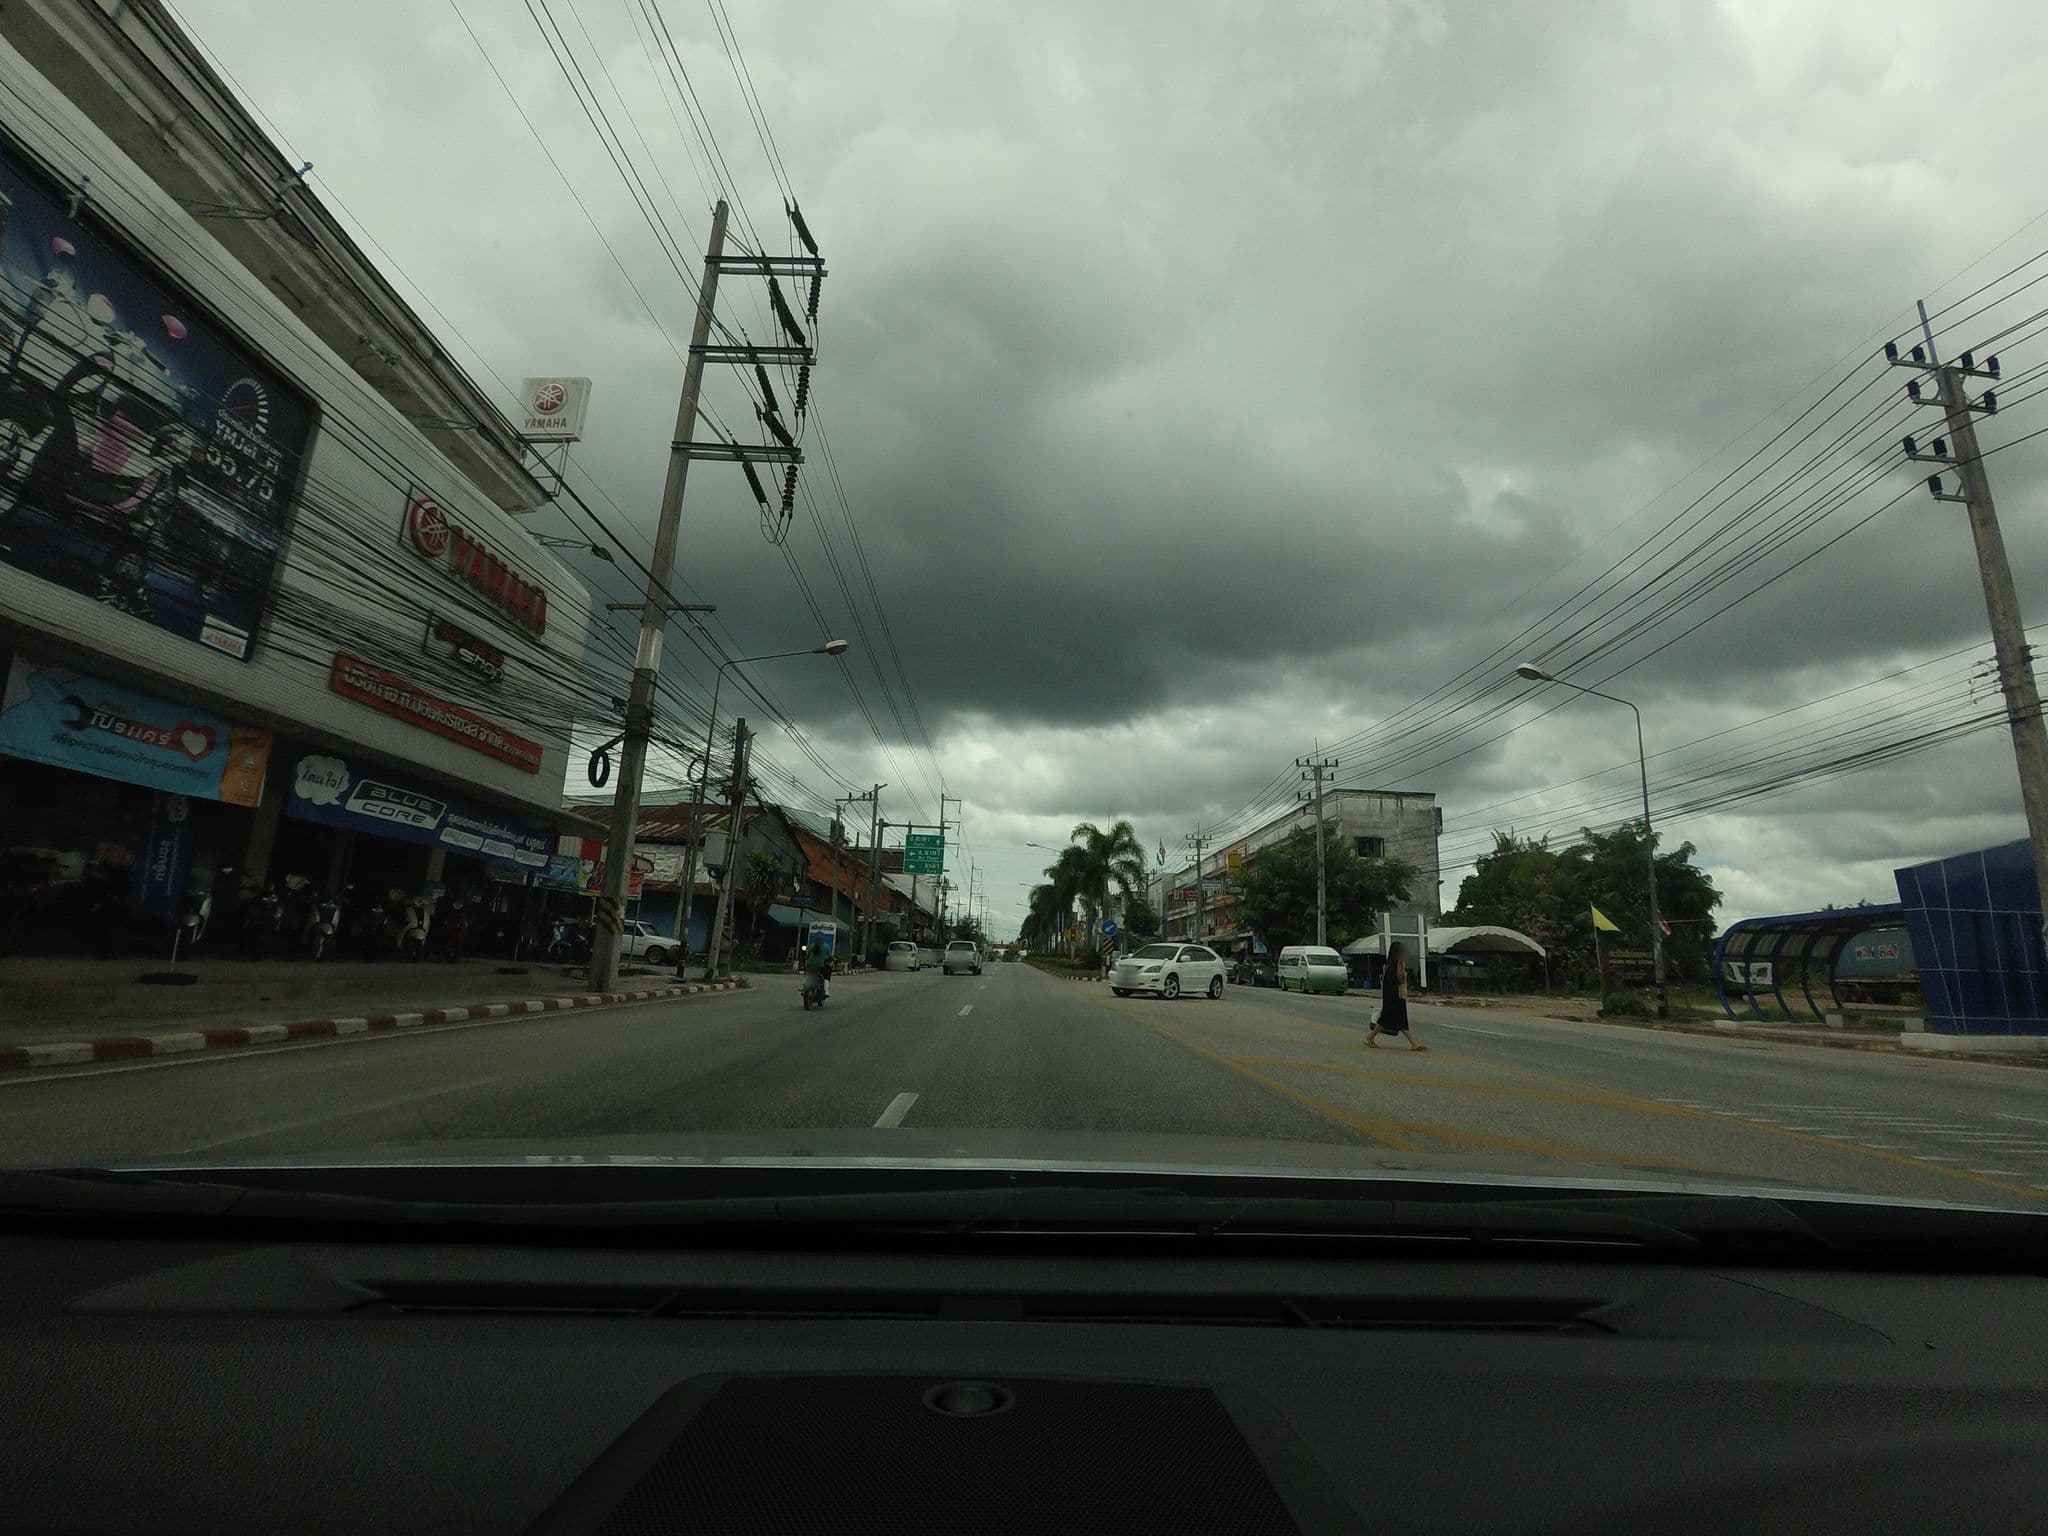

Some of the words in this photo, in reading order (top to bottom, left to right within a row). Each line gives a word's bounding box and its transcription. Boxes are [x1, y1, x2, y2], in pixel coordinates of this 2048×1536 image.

[524, 418, 567, 429] YAMAHA
[450, 525, 546, 635] YAMAHA
[370, 787, 434, 812] BLUE
[362, 802, 427, 824] CORE
